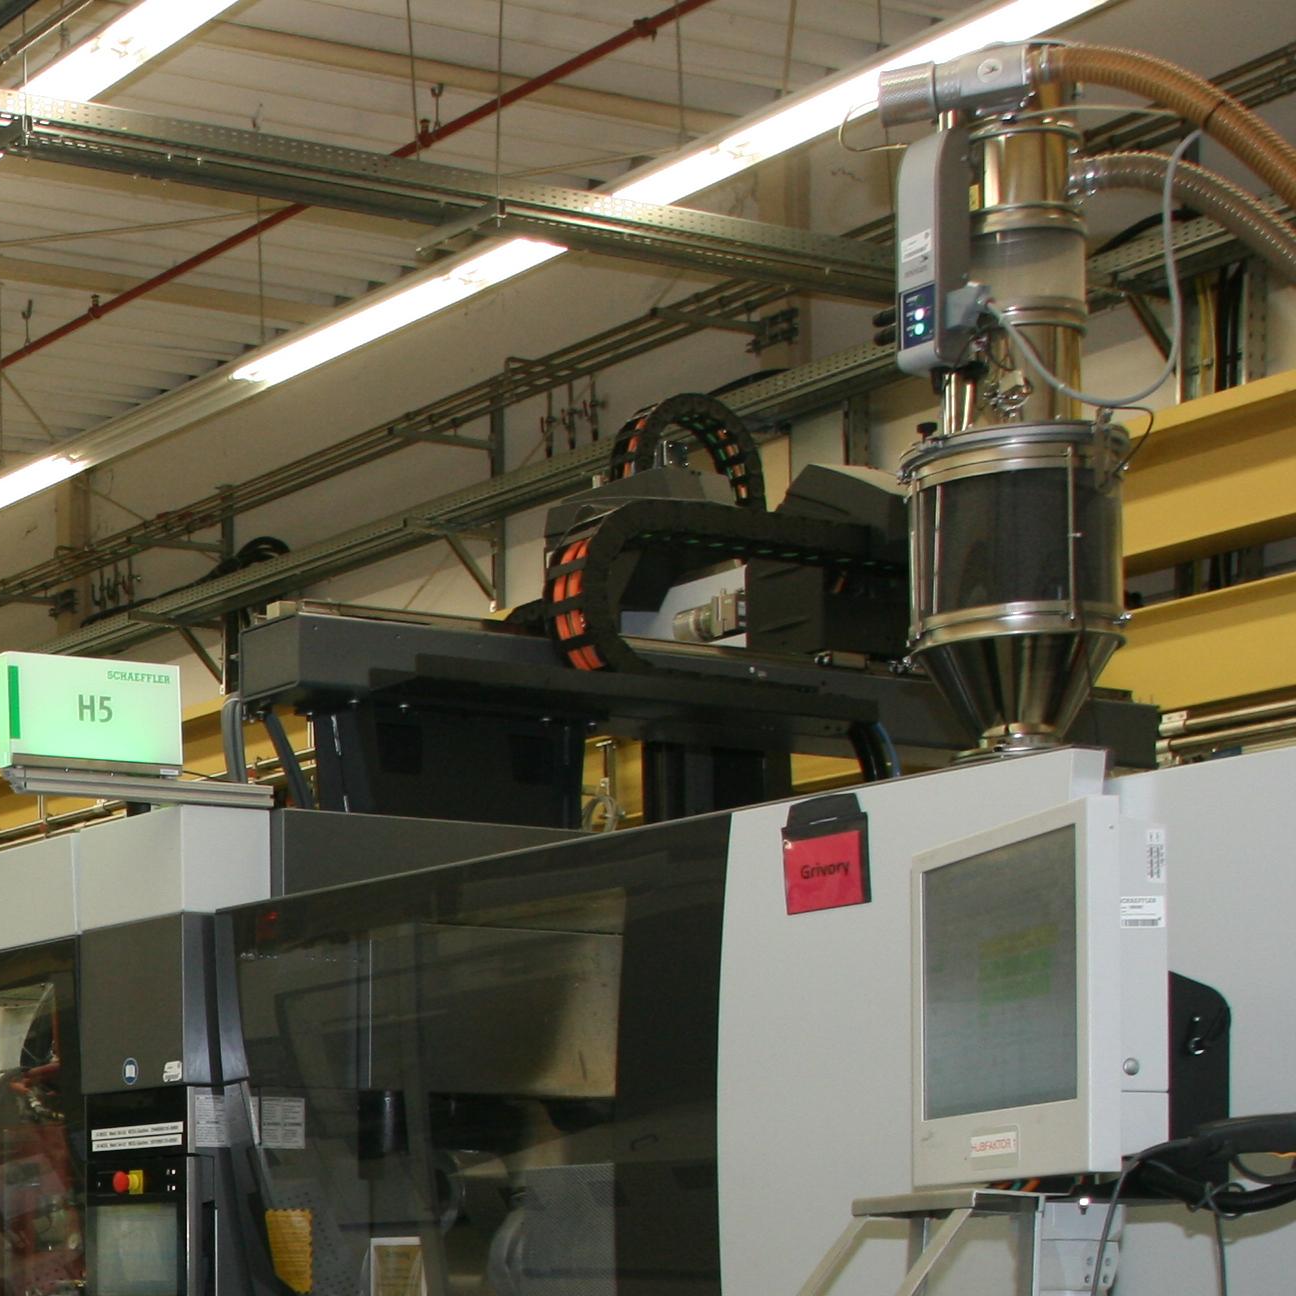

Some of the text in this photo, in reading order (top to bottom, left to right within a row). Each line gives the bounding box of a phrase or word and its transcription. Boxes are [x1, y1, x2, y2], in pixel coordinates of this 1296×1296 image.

[107, 670, 171, 685] SCHAEFFLER
[77, 693, 114, 723] H5
[800, 860, 850, 880] Grivory
